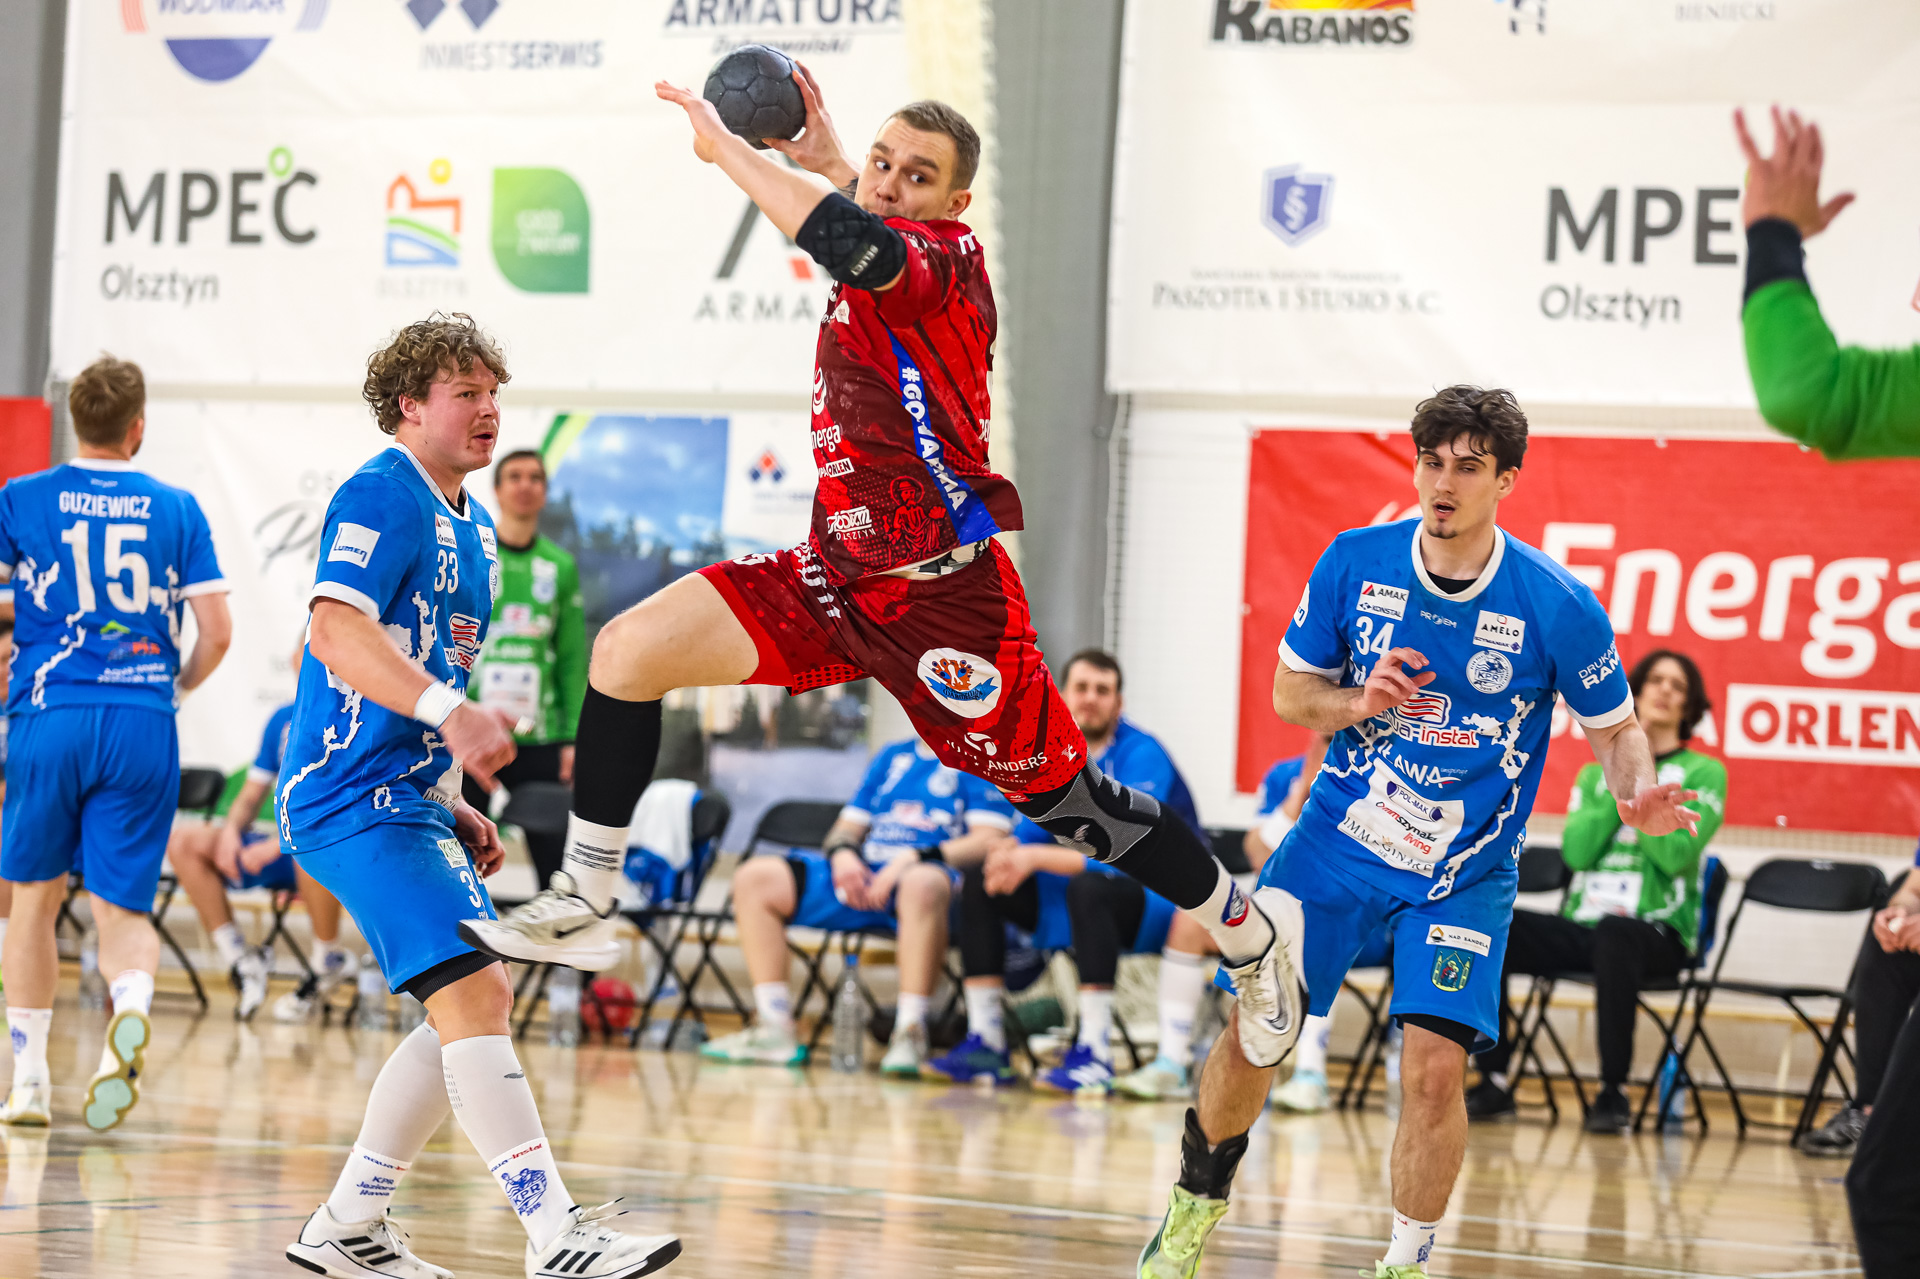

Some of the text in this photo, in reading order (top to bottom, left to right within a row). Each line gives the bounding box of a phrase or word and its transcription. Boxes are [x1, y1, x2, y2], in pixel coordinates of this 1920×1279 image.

[664, 0, 905, 25] ARMATURA
[105, 170, 317, 244] MPEC
[1546, 188, 1740, 264] MPE
[101, 263, 219, 307] Olsztyn
[695, 293, 816, 322] ARMA
[1540, 284, 1682, 328] Olsztyn
[811, 424, 841, 452] nerga
[59, 491, 151, 519] GUZIEWICZ
[60, 520, 150, 614] 15
[434, 549, 459, 594] 33
[1377, 588, 1407, 602] AMAK
[1371, 604, 1402, 618] KONSTAL
[1355, 616, 1395, 660] 34
[1481, 623, 1520, 637] AMELO
[1477, 671, 1501, 683] KPR
[1741, 700, 1920, 754] ORLEN
[988, 751, 1049, 773] ANDERS
[1398, 789, 1429, 815] POL-MAK
[1402, 832, 1432, 855] living
[513, 1183, 541, 1206] KPR
